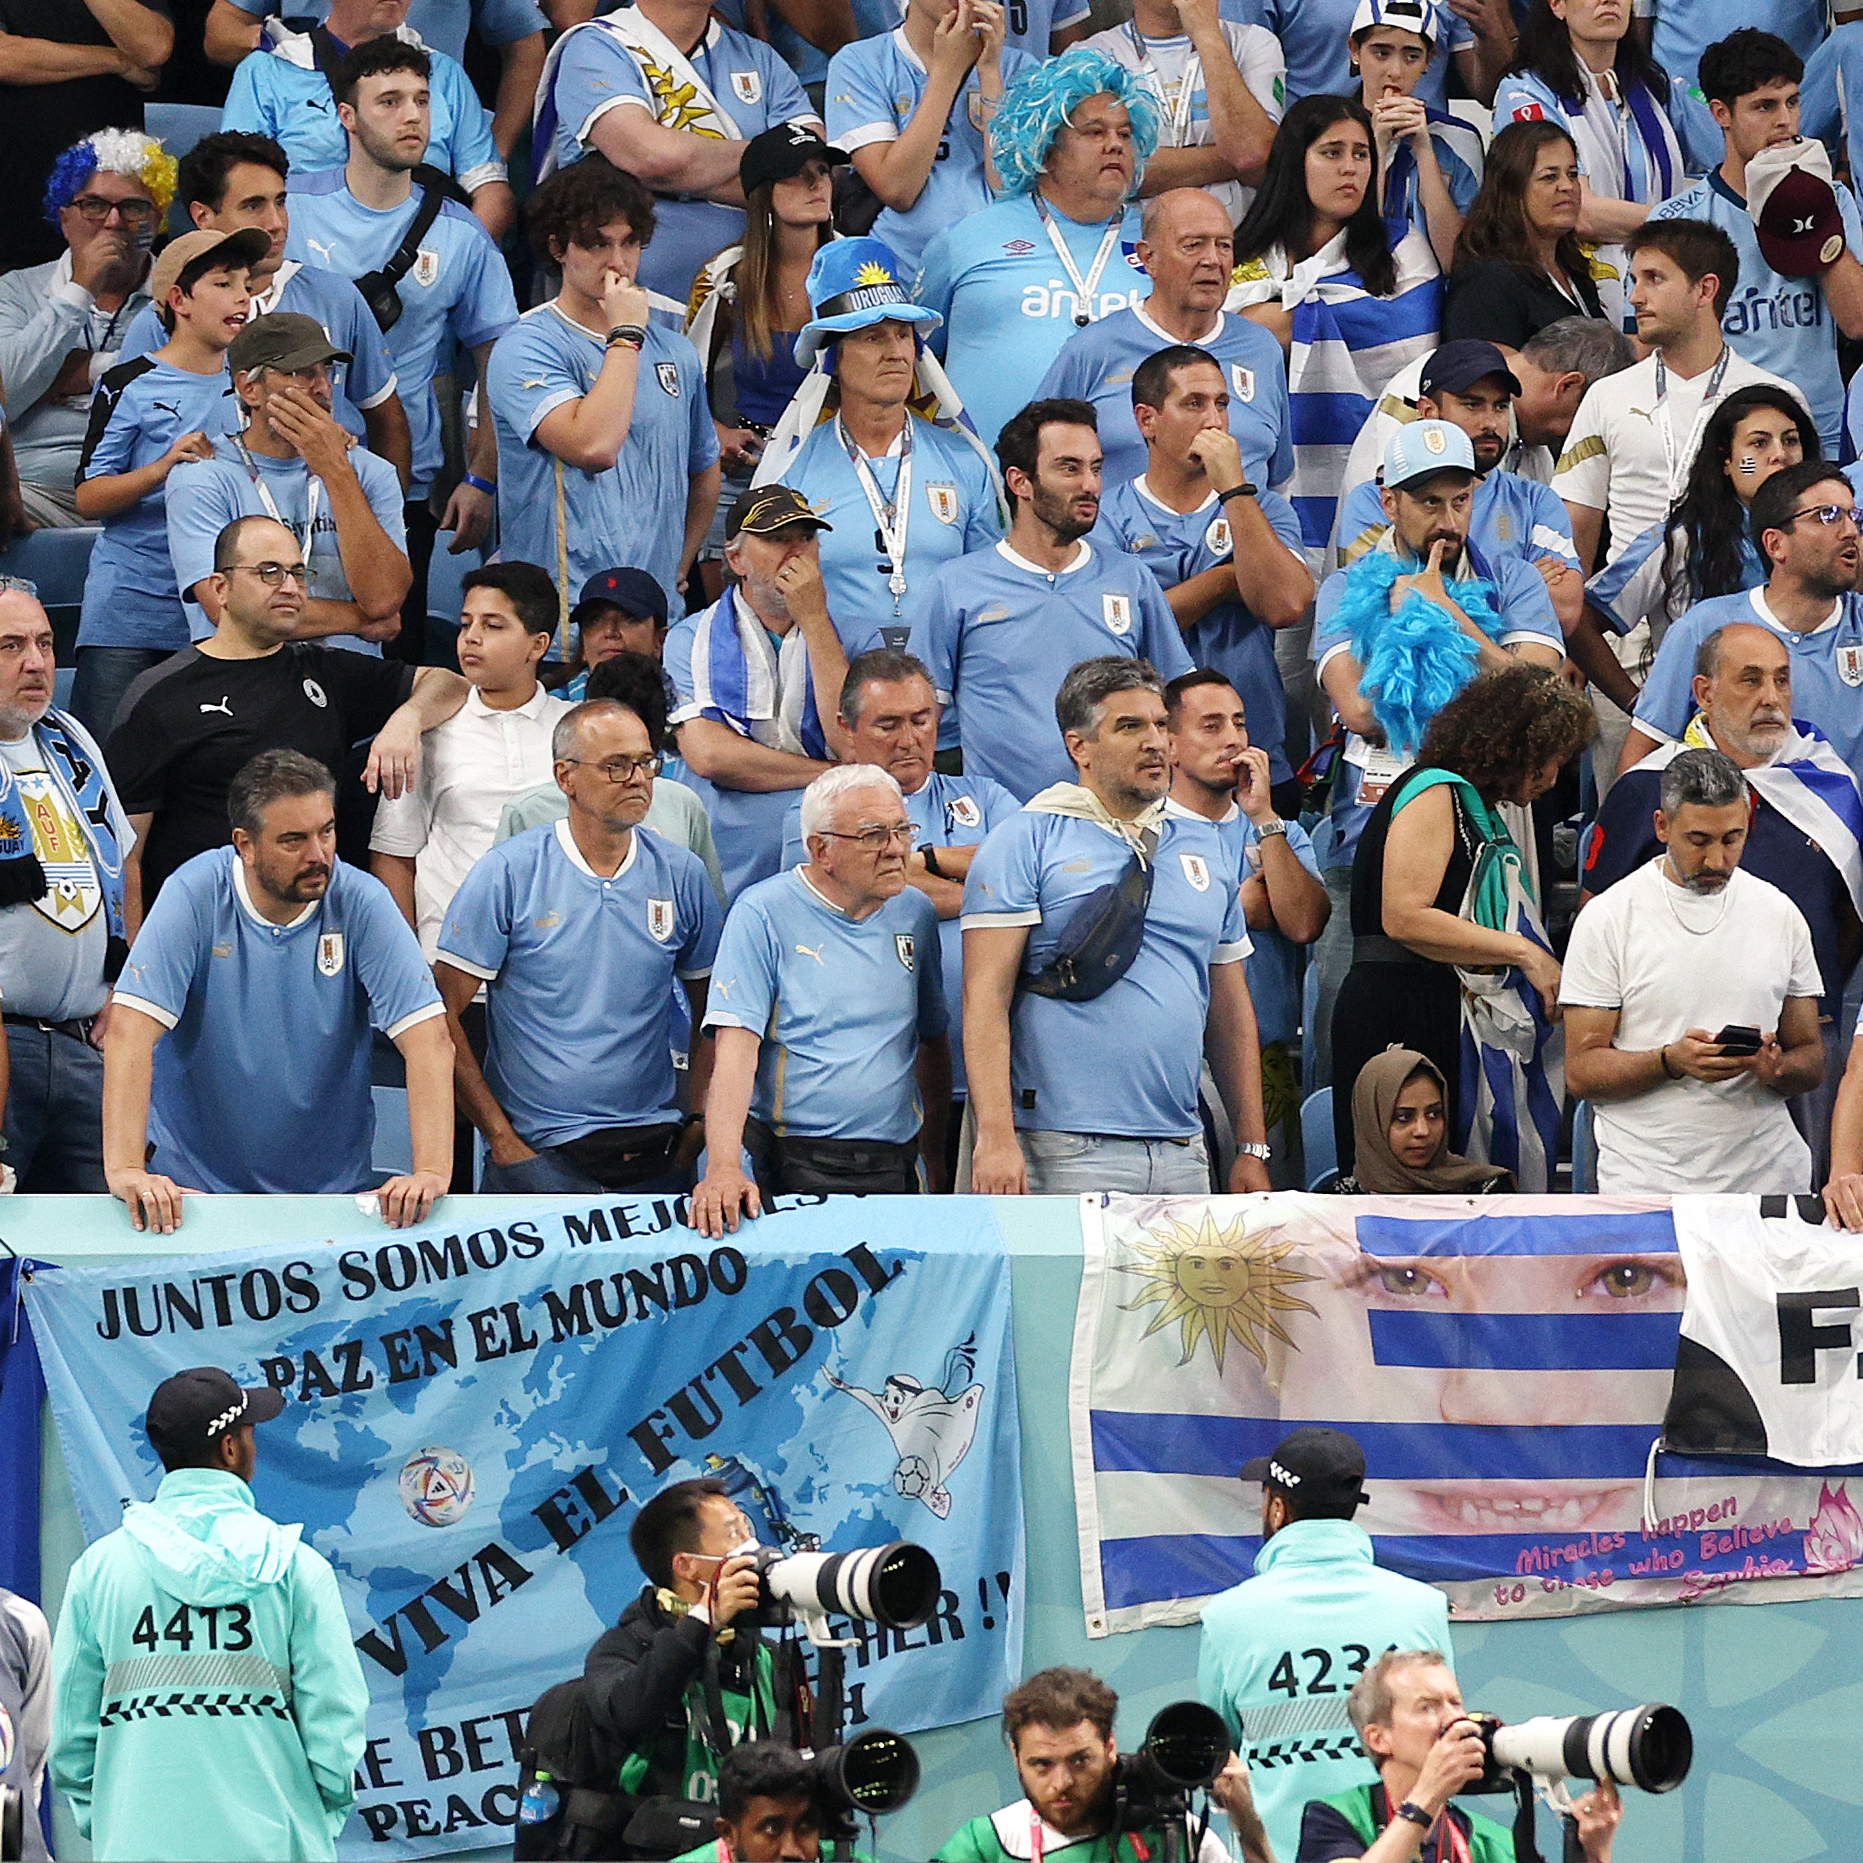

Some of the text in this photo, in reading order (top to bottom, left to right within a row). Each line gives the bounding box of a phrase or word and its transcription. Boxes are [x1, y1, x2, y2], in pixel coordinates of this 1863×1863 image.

[97, 1262, 321, 1339] JUNTOS
[340, 1220, 545, 1302] SOMOS
[258, 1246, 748, 1404] PAZ EN EL MUNDO
[355, 1241, 907, 1677] VIVA EL FUTBOL
[1493, 1583, 1525, 1605] to
[1628, 1548, 1684, 1575] who
[1699, 1518, 1794, 1561] Believe
[1515, 1495, 1737, 1576] Miracles happen
[132, 1606, 253, 1653] 4413
[1268, 1644, 1399, 1699] 423
